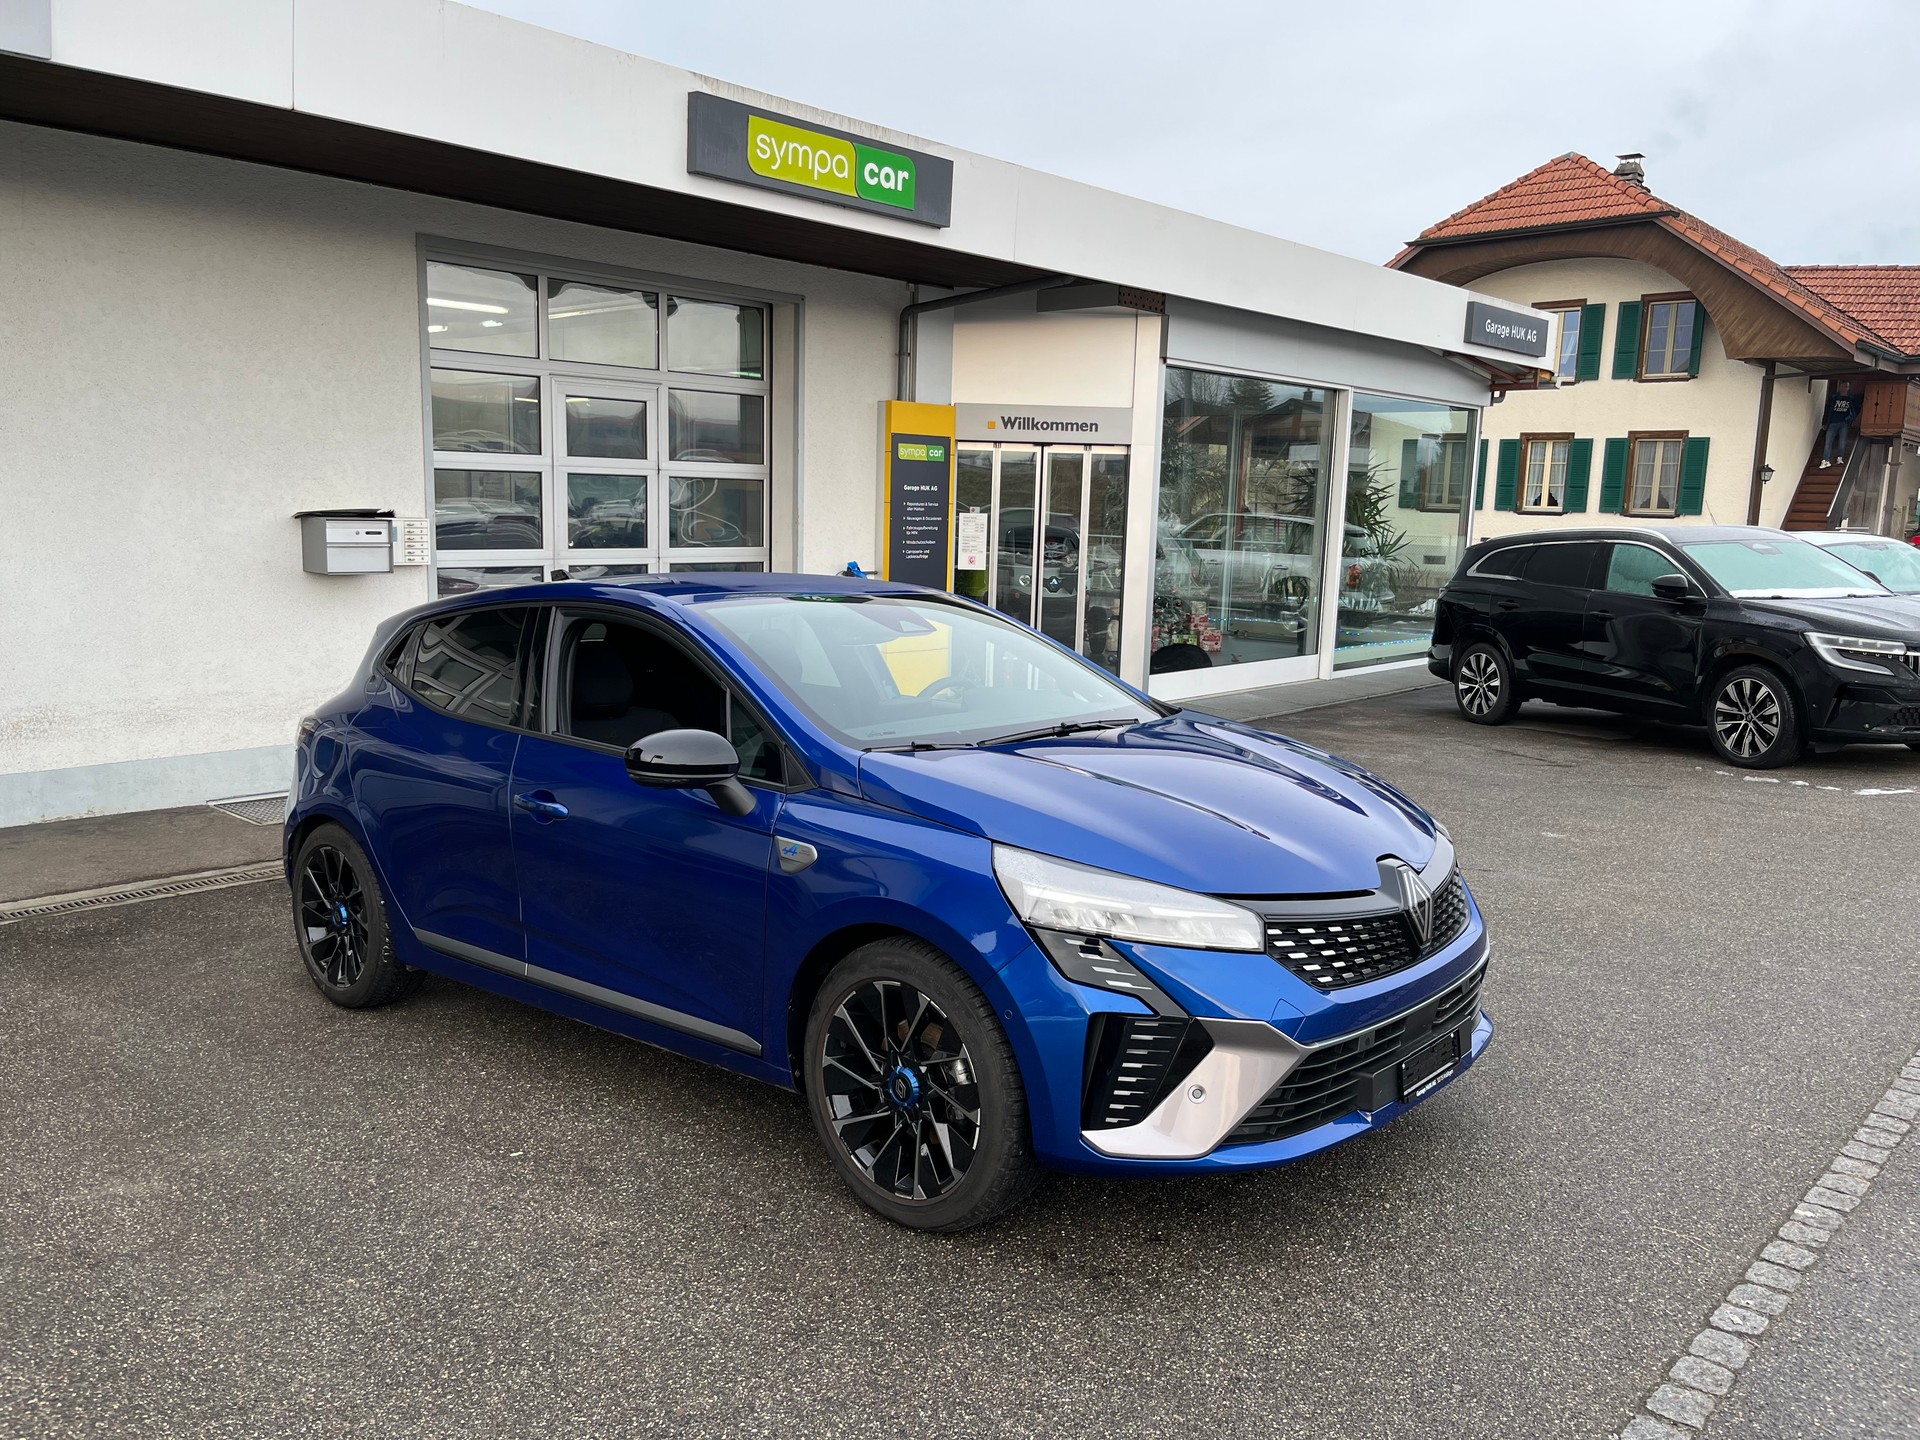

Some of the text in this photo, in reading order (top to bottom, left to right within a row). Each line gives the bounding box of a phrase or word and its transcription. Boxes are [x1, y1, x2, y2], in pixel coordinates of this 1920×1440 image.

[756, 133, 909, 191] sympa car
[1485, 319, 1537, 342] Garage HUK AG
[1000, 416, 1099, 432] Willkommen
[900, 447, 943, 458] sympa car
